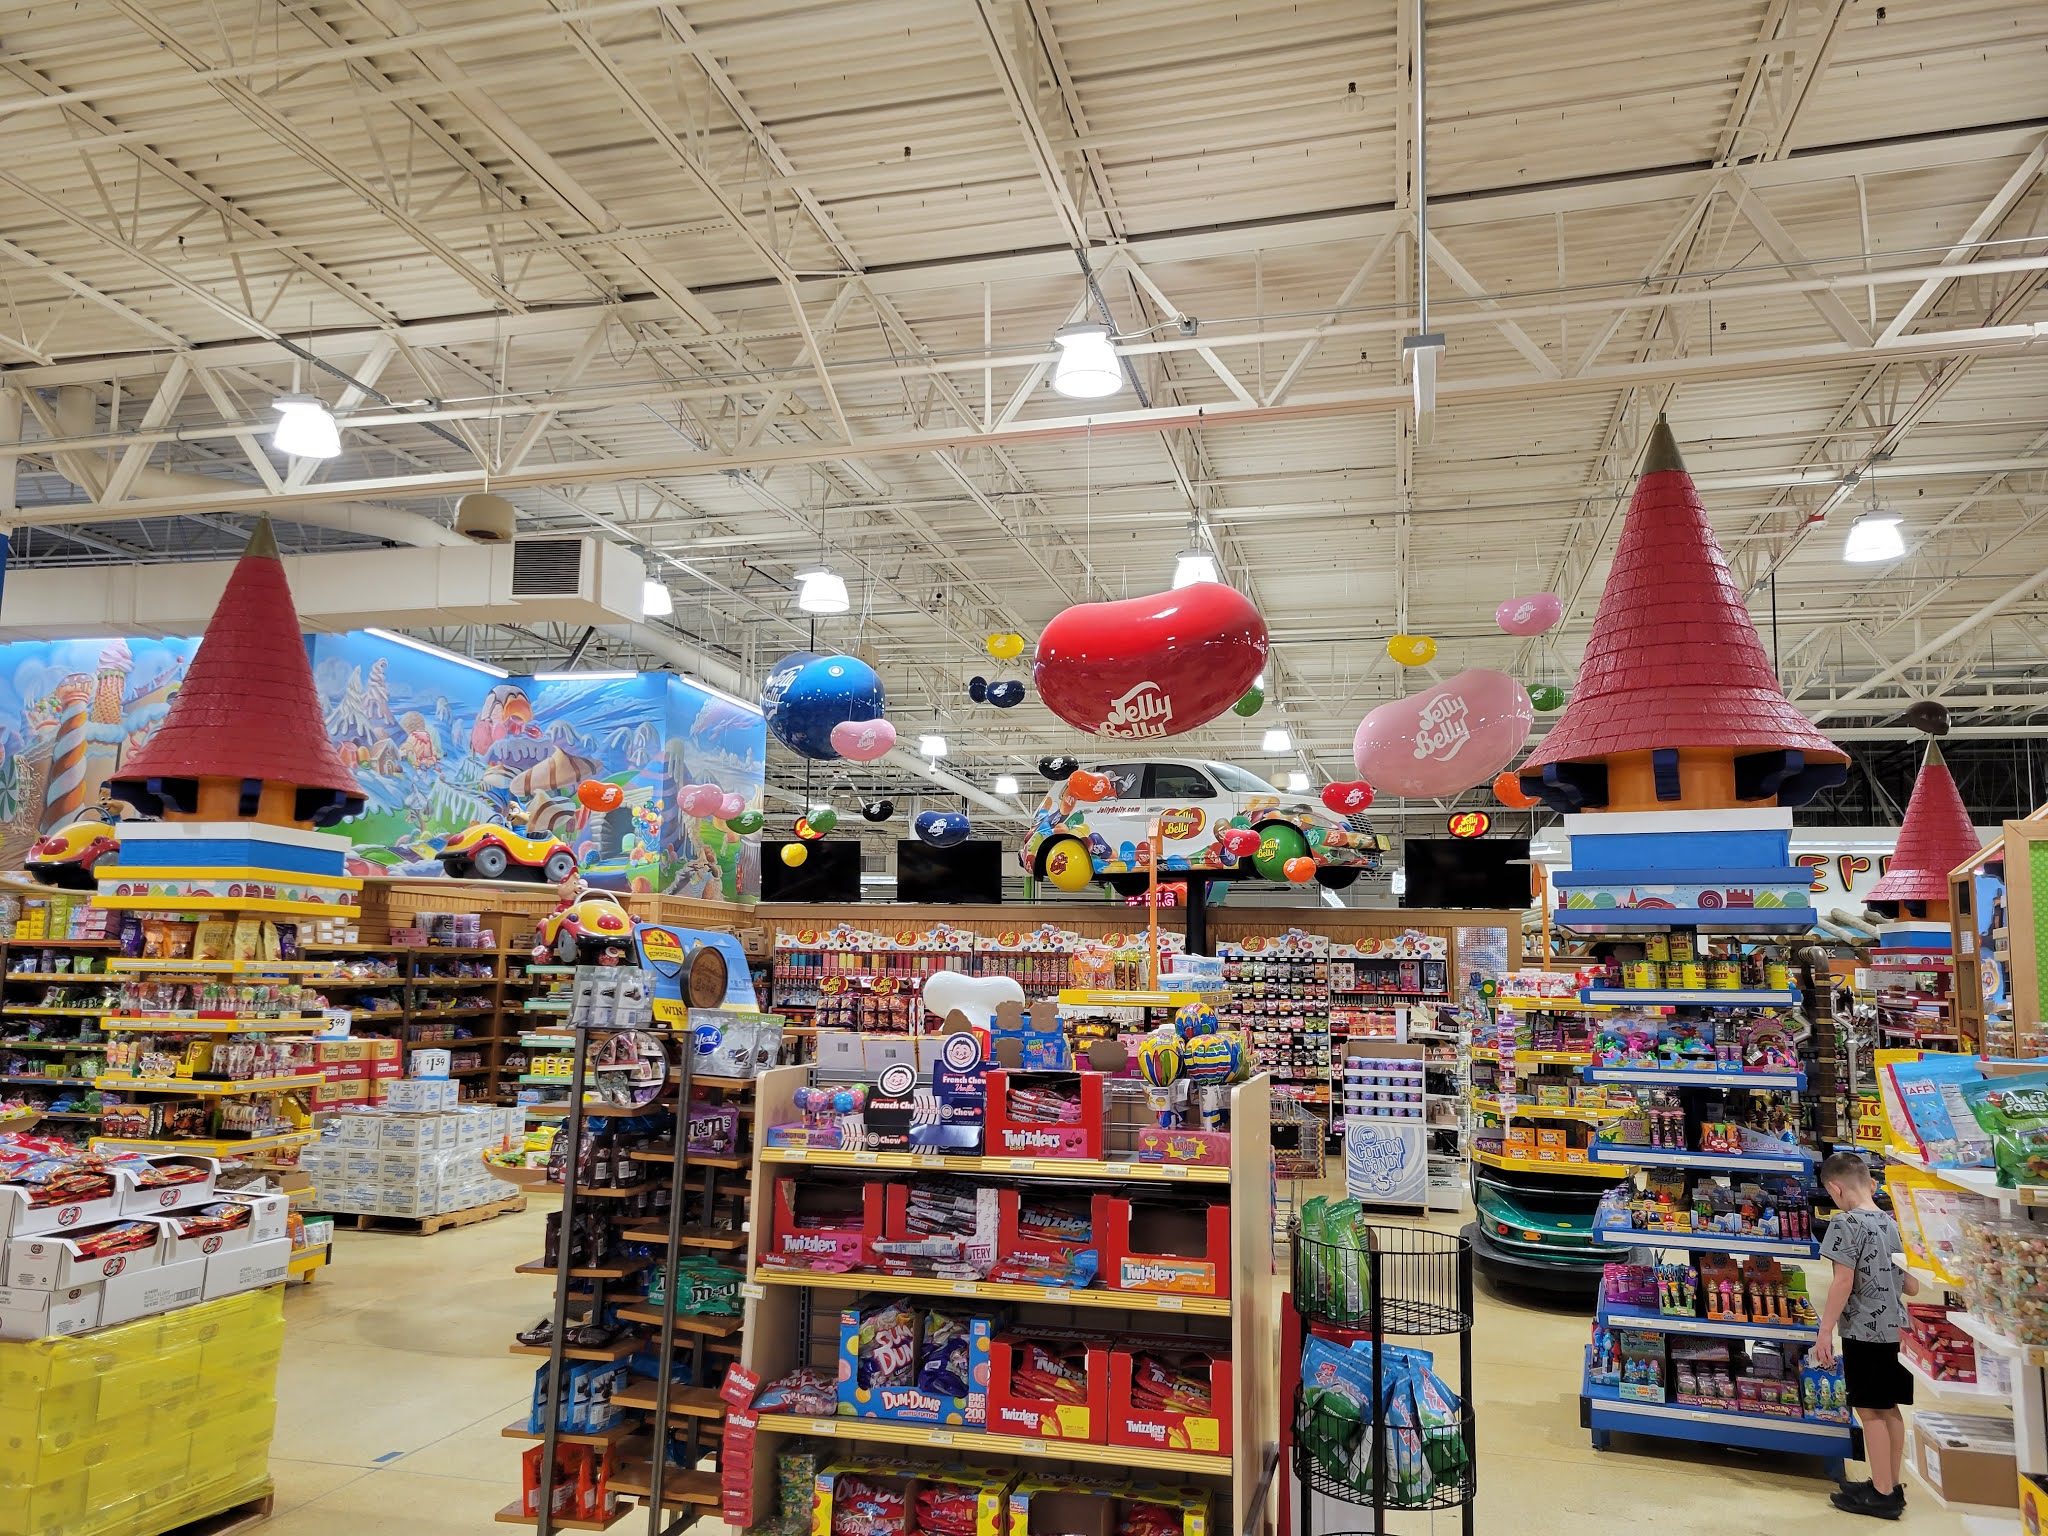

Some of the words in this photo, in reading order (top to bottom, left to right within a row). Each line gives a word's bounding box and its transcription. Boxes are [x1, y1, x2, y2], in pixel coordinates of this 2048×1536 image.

[1108, 681, 1173, 725] Jelly
[1418, 693, 1469, 731] Jelly
[1095, 722, 1168, 741] Belly
[1413, 718, 1471, 762] Belly
[1097, 806, 1141, 815] JellyBelly.com
[1262, 838, 1279, 850] Jelly
[1257, 848, 1276, 862] Belly
[662, 1005, 683, 1016] WIN
[694, 1030, 718, 1051] York
[377, 1065, 399, 1073] POPCORN
[942, 1075, 967, 1084] French
[870, 1101, 899, 1109] French
[900, 1101, 915, 1109] Che
[2006, 1092, 2048, 1105] BLACK
[953, 1108, 975, 1116] Chew
[880, 1136, 901, 1144] Chew
[1002, 1129, 1061, 1148] Twizzlers
[1742, 1141, 1780, 1150] CUPCAKE
[1354, 1137, 1406, 1160] COTTON
[782, 1234, 837, 1252] Twizzlers
[1832, 1236, 1842, 1252] FILA
[1864, 1249, 1879, 1263] FILA
[1124, 1263, 1177, 1282] Twizzlers
[1870, 1304, 1887, 1319] FILA
[729, 1370, 756, 1391] Twizzlers
[881, 1390, 942, 1412] DUM-DUMS
[969, 1393, 986, 1401] BIG
[965, 1408, 986, 1419] 200
[1001, 1407, 1039, 1421] Twizzlers
[729, 1413, 756, 1429] Twizzlers
[1126, 1420, 1166, 1434] Twizzlers
[856, 1501, 888, 1516] Original
